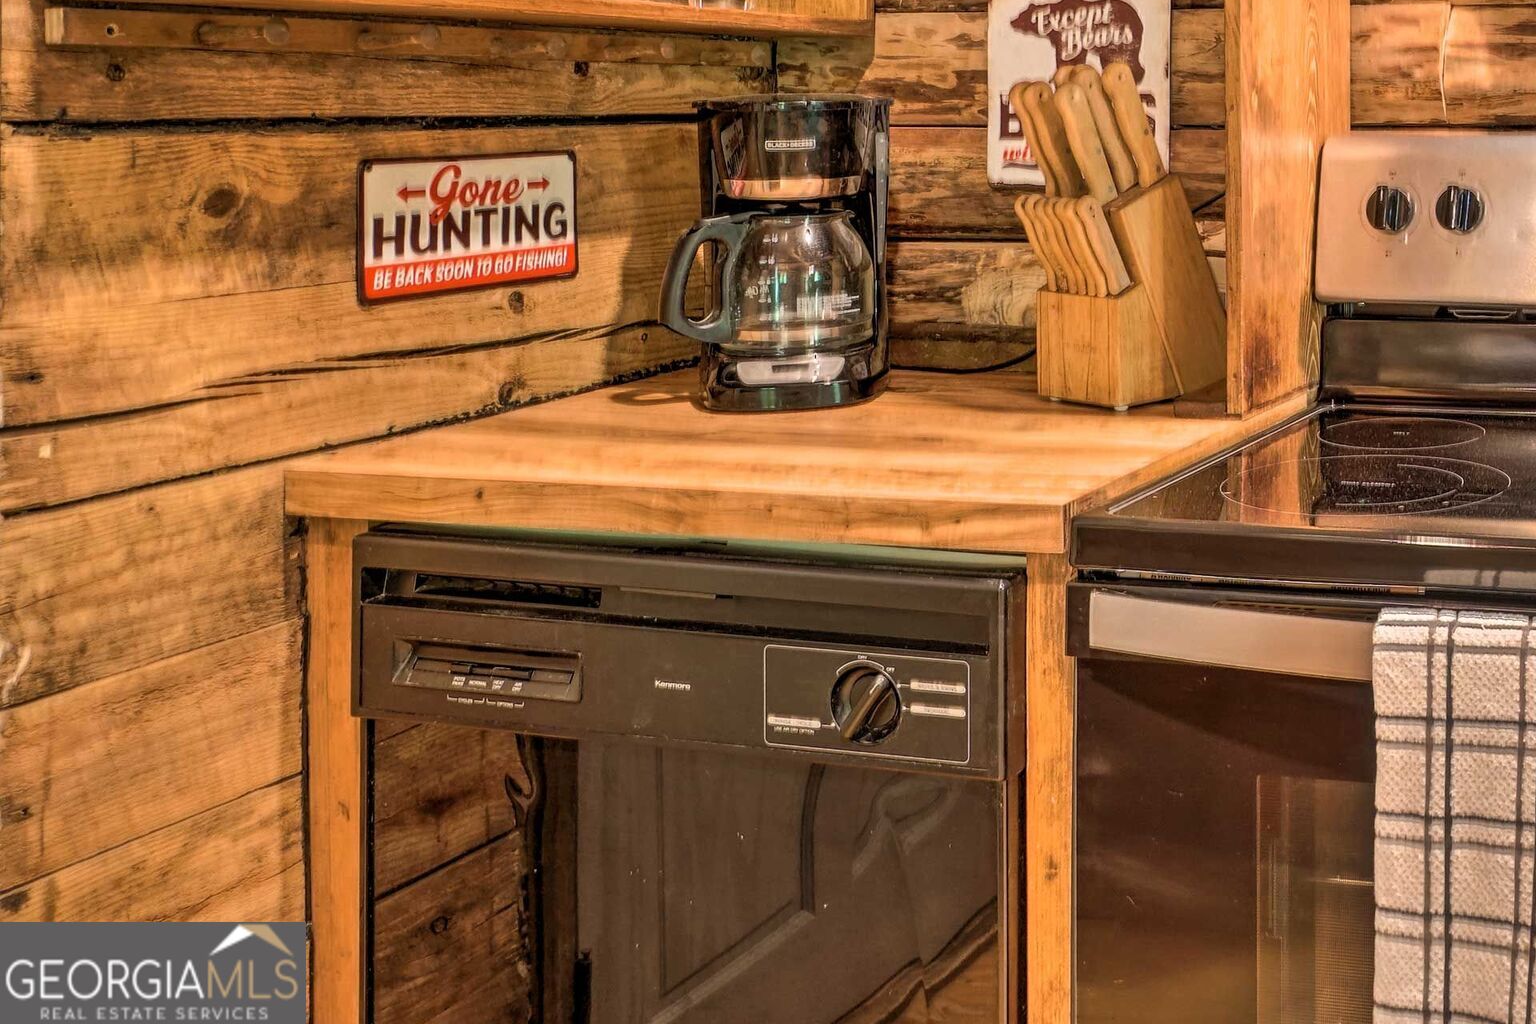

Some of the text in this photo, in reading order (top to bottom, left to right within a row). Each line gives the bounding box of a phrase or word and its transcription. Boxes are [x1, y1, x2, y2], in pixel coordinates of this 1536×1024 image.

[1060, 23, 1134, 62] Bears
[429, 164, 525, 225] Gone
[372, 201, 568, 258] HUNTING
[373, 246, 568, 291] BE BACK SOON TO GO FISHING!
[655, 679, 691, 691] Kenmore
